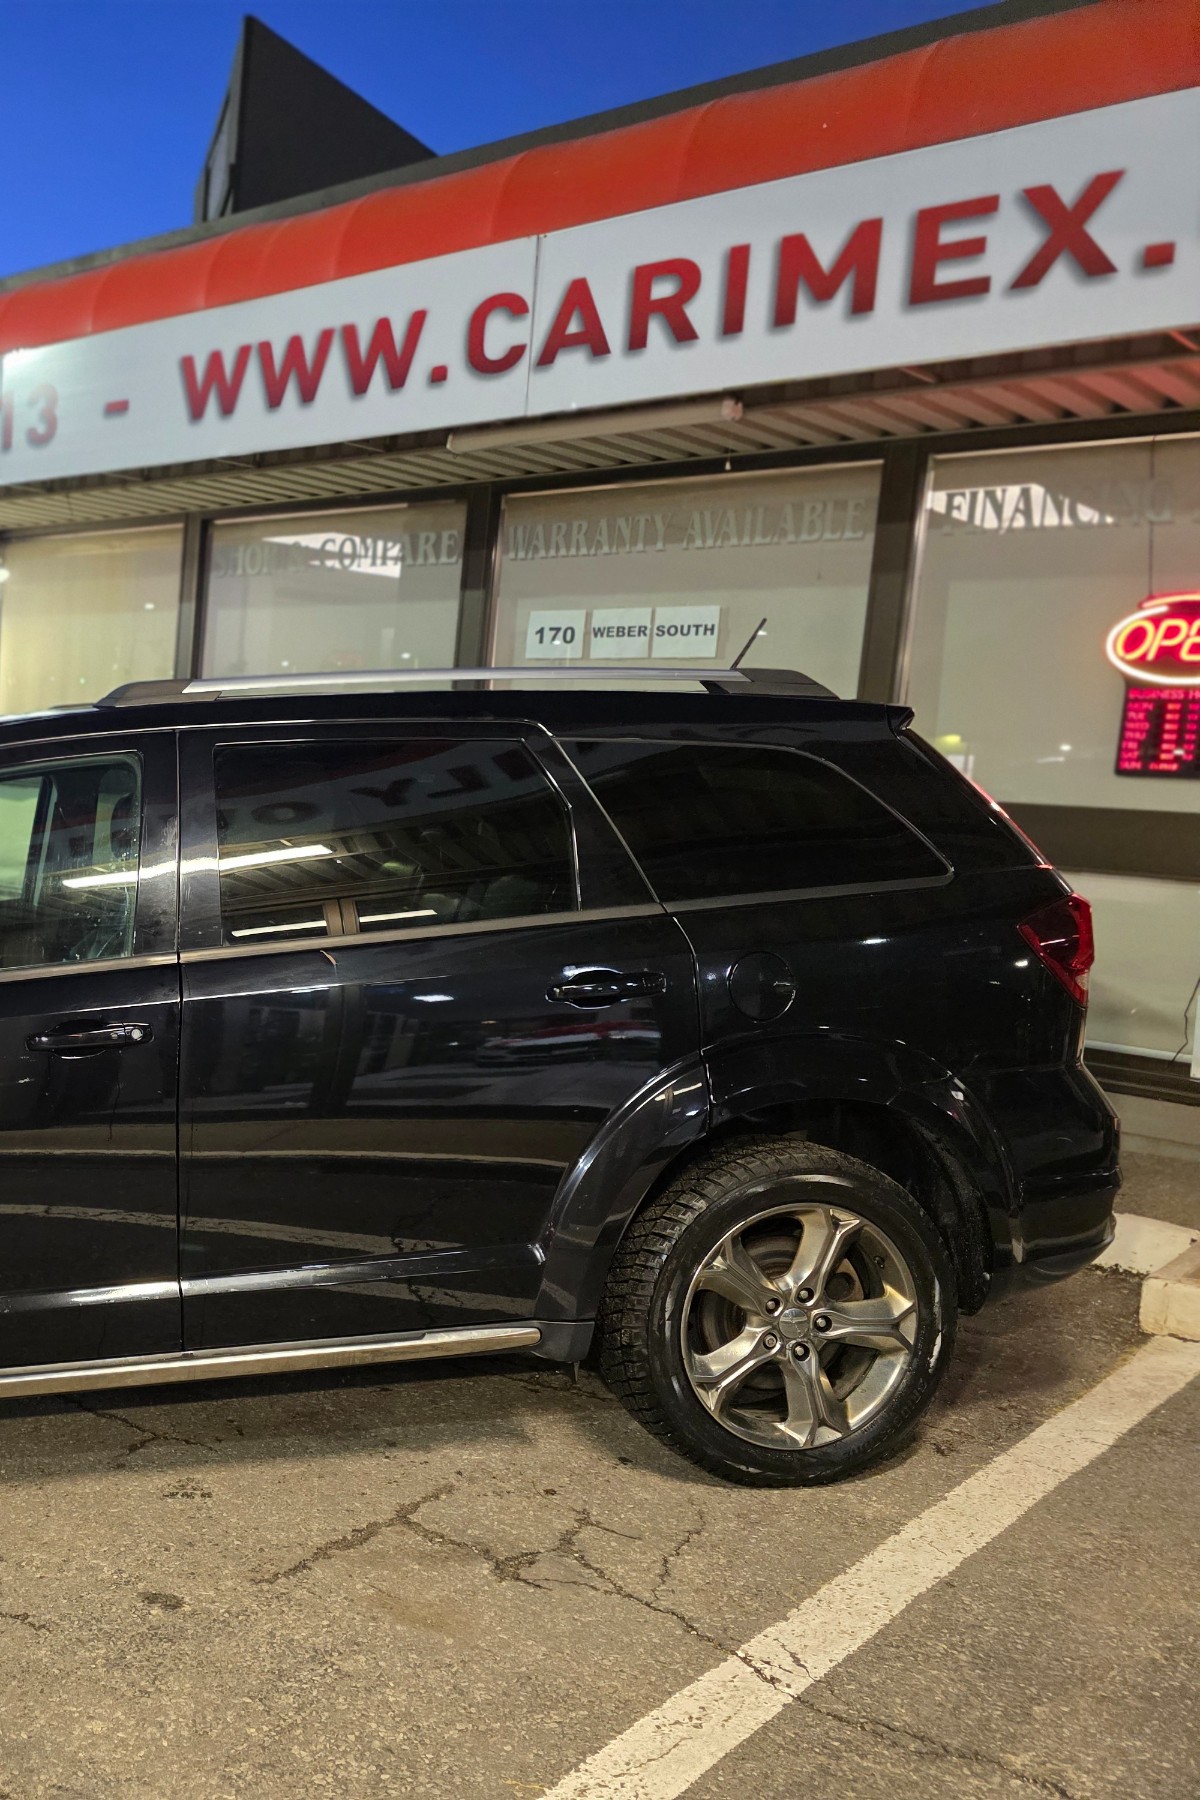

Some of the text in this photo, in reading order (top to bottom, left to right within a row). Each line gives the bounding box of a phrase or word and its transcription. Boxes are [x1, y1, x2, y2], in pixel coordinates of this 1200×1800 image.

[320, 530, 460, 571] COMPARE
[508, 499, 866, 561] WARRANTY AVAILABLE
[534, 623, 716, 644] 170 WEBER SOUTH
